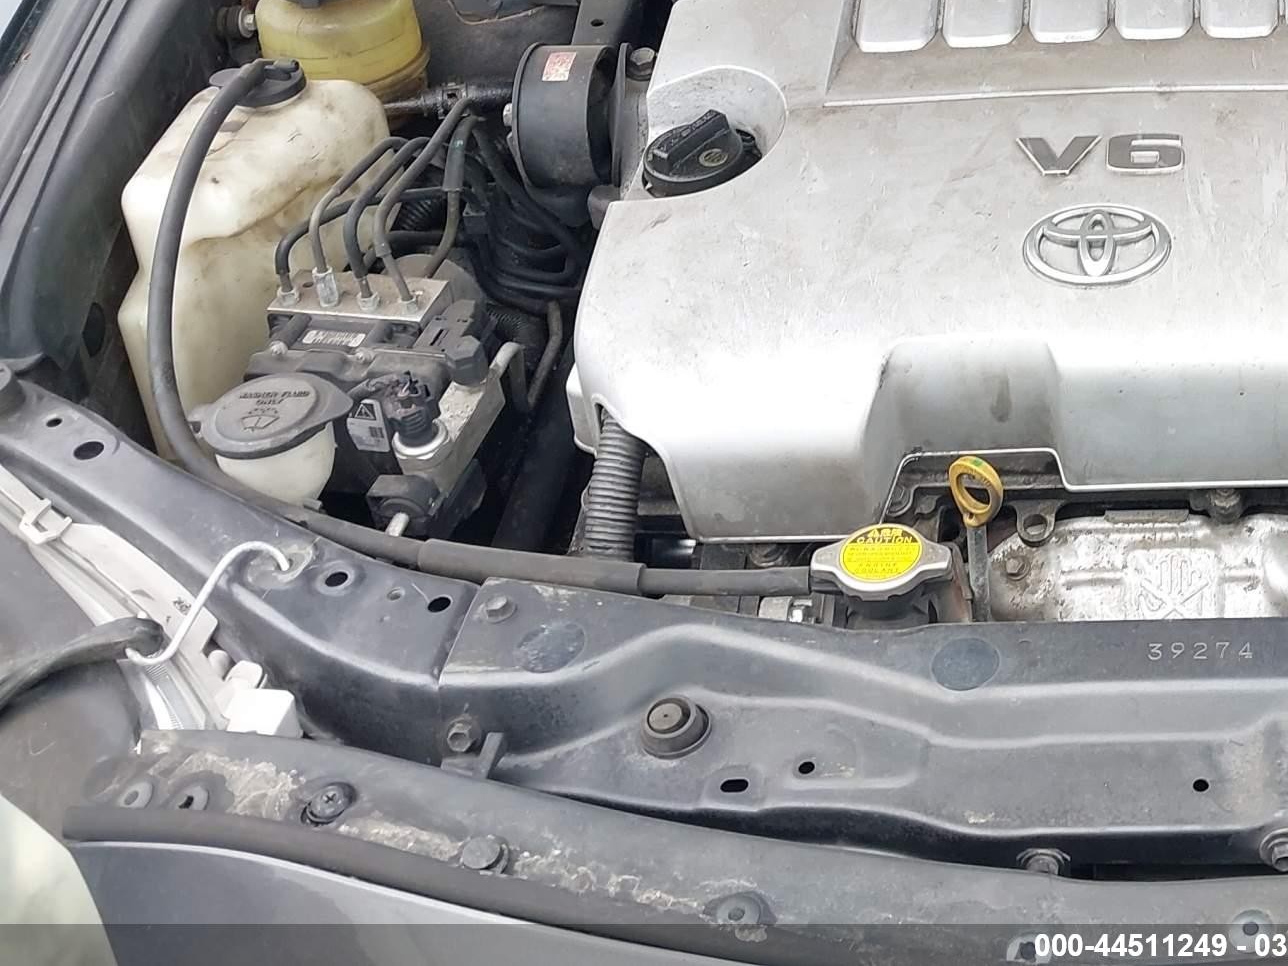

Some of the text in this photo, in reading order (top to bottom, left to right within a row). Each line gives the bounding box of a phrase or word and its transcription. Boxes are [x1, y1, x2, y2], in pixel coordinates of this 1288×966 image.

[1016, 133, 1185, 176] V6
[857, 536, 913, 544] CAUTION
[1148, 642, 1254, 660] 39274
